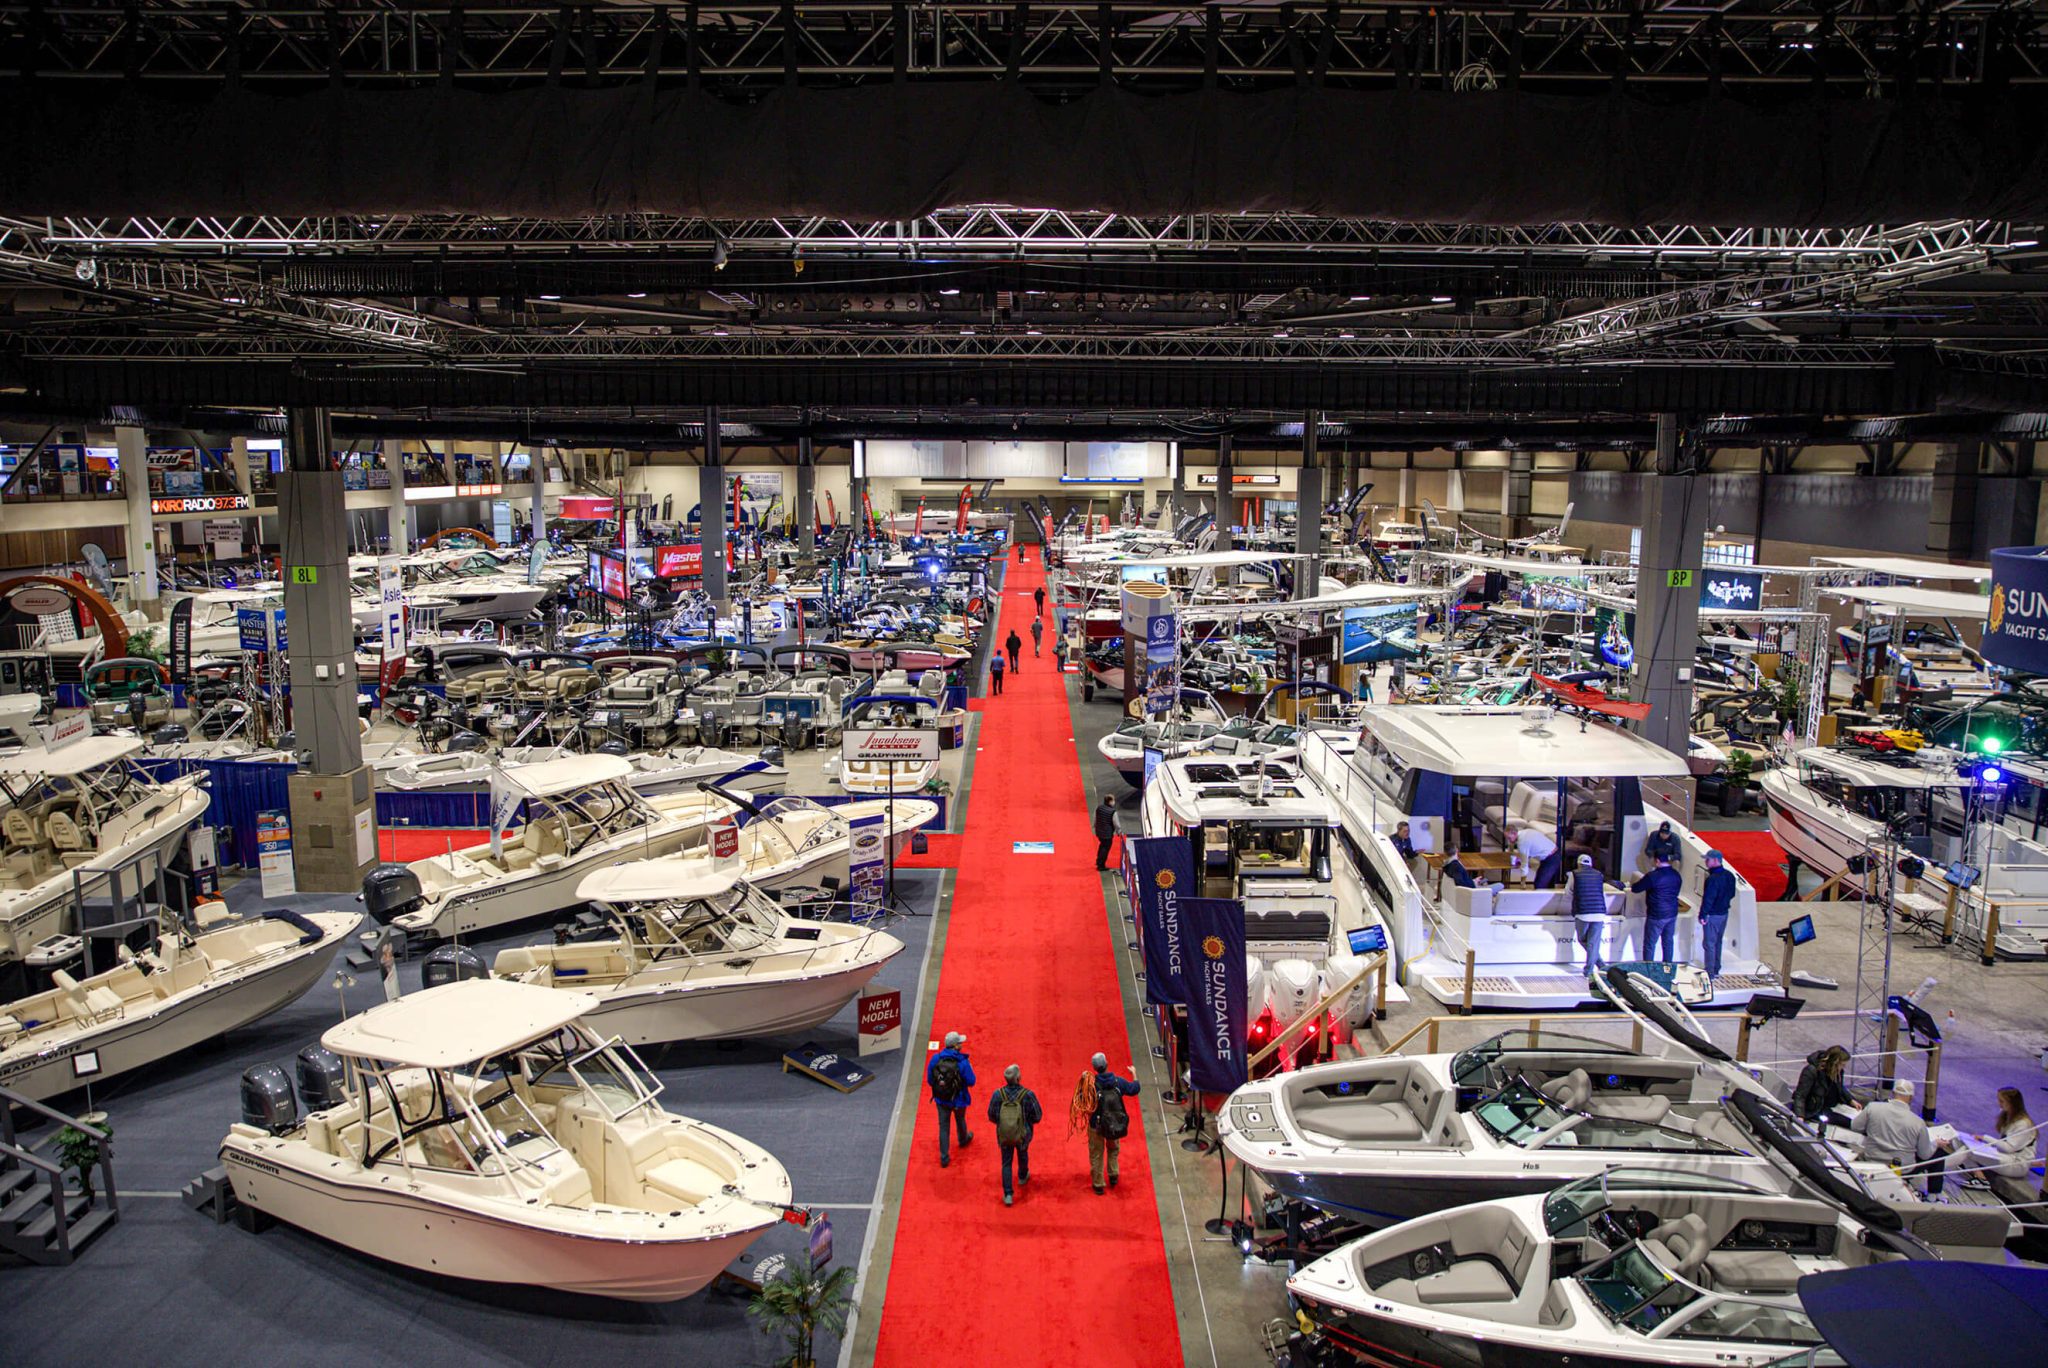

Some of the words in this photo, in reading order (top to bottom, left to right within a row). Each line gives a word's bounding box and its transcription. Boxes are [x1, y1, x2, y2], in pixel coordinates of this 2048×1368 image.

[298, 567, 312, 583] 8L
[1672, 571, 1687, 586] 8P
[240, 617, 266, 630] MASTER
[389, 613, 400, 649] F
[2005, 622, 2037, 640] YACHT
[2037, 628, 2048, 641] S
[175, 620, 187, 651] MODEL
[175, 653, 187, 673] NEW
[715, 839, 737, 851] MODEL!
[719, 832, 733, 842] NEW
[1164, 890, 1182, 976] SUNDANCE
[1203, 960, 1211, 984] YACHT
[1205, 984, 1213, 1006] SALES
[868, 998, 892, 1012] NEW
[1211, 961, 1231, 1061] SUNDANCE
[861, 1008, 899, 1025] MODEL!
[229, 1152, 281, 1175] GRADY-WHITE
